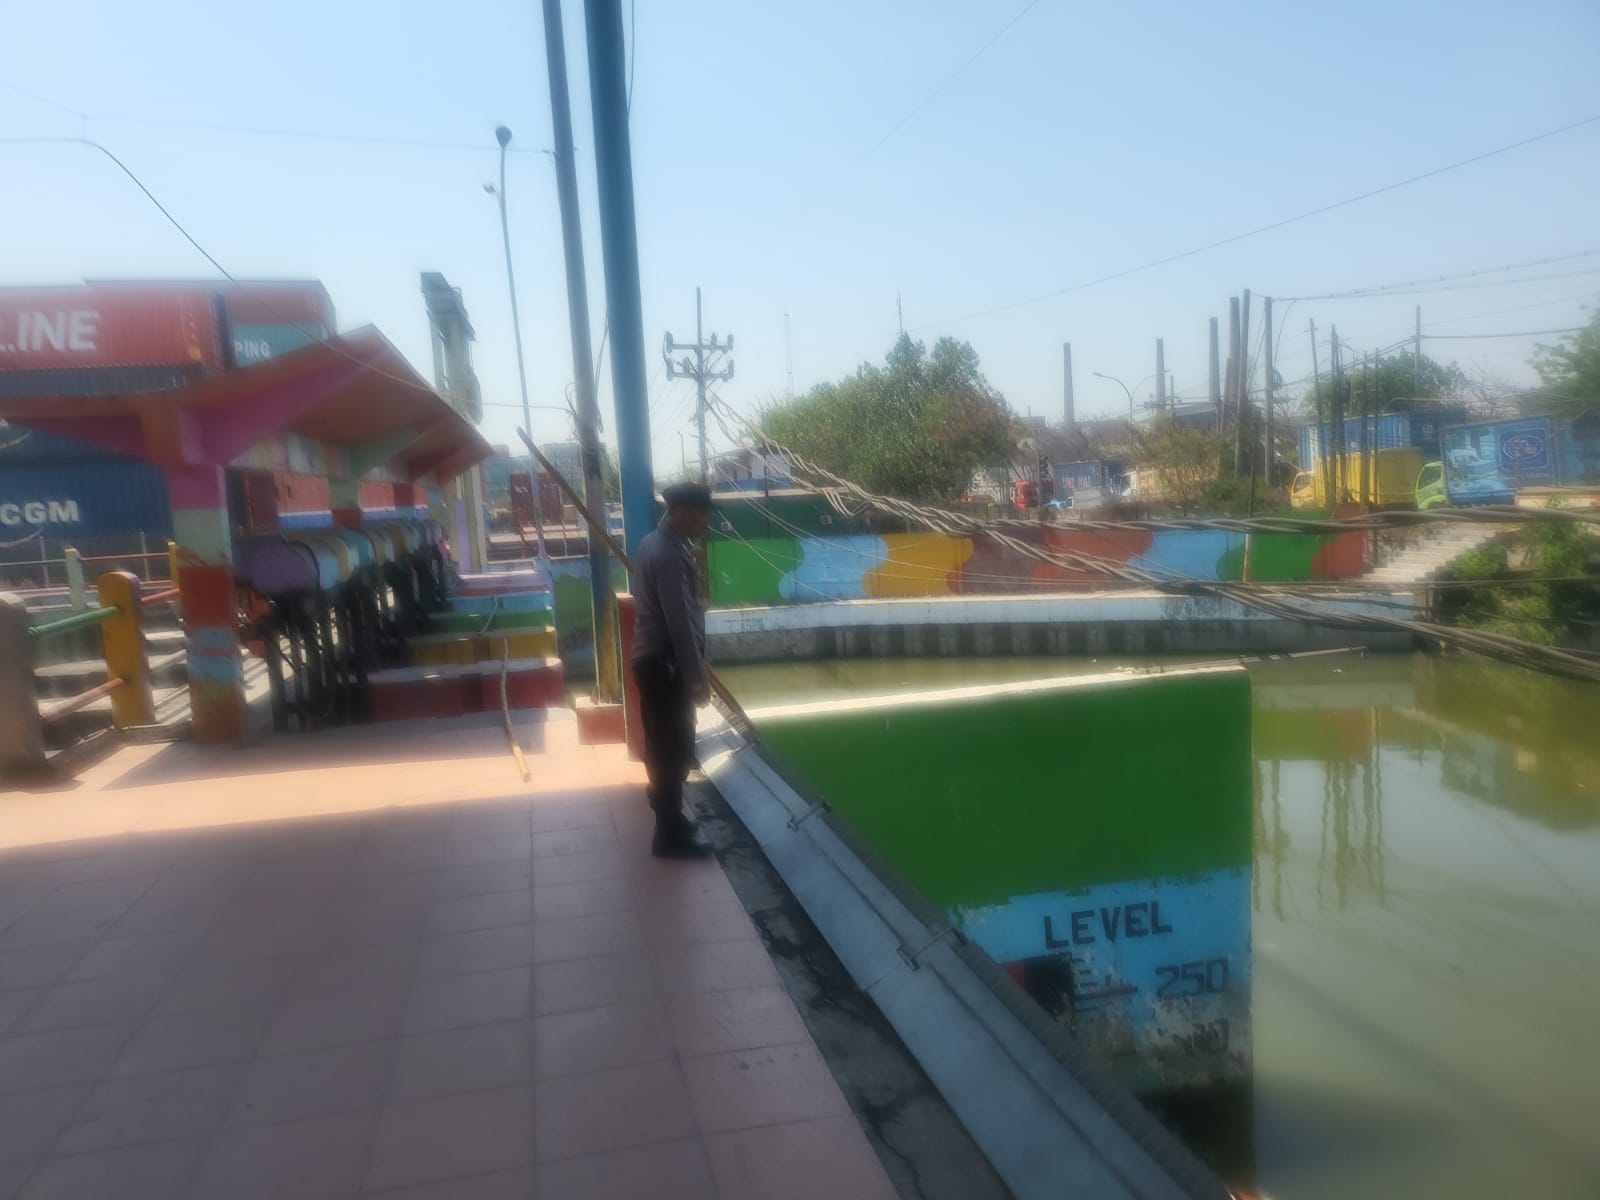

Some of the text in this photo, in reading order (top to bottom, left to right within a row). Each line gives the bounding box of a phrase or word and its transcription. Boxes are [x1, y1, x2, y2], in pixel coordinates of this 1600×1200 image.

[0, 500, 79, 526] CGM
[1044, 901, 1172, 949] LEVEL
[1155, 958, 1229, 1000] 250
